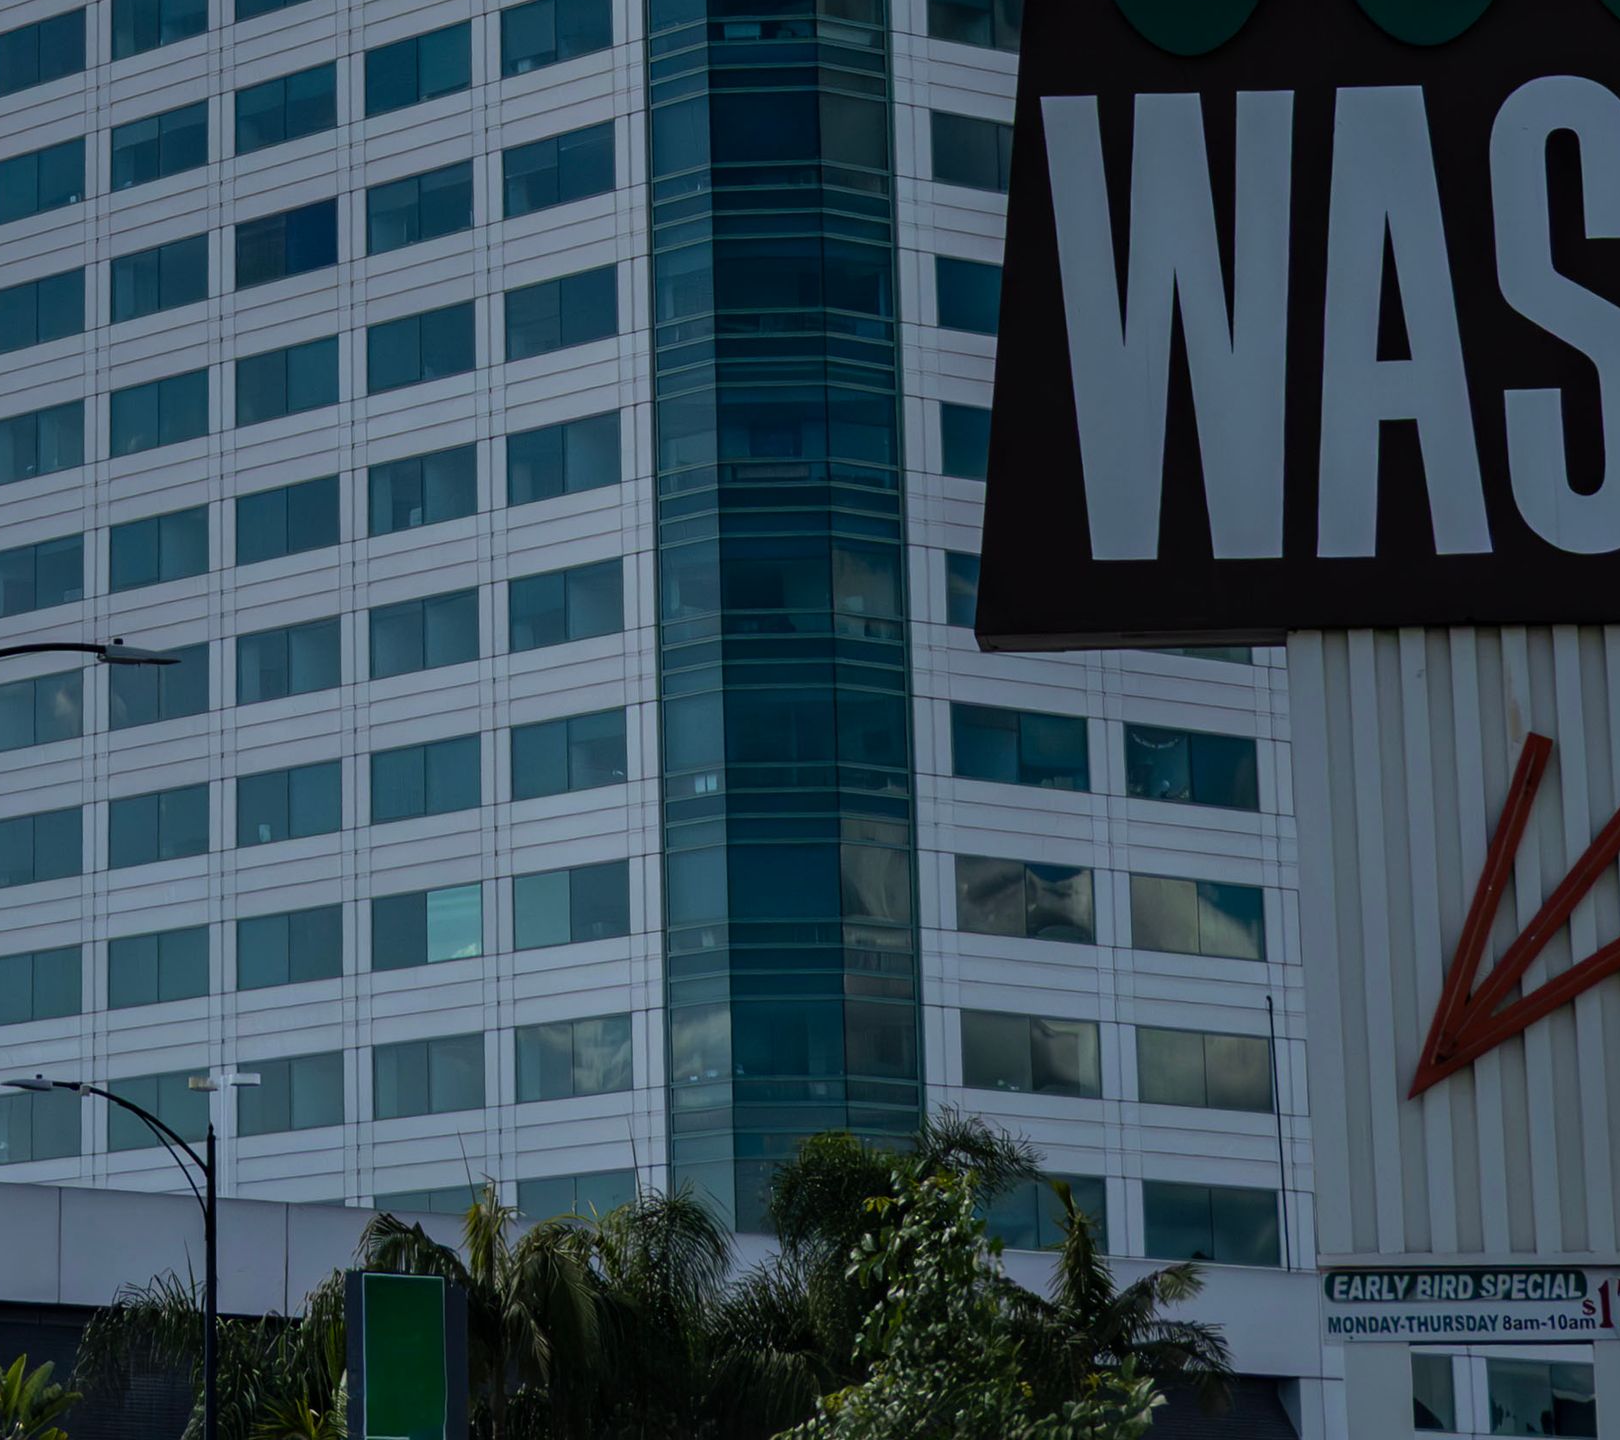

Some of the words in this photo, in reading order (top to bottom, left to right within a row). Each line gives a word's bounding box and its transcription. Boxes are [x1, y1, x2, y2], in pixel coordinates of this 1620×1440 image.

[1333, 1275, 1410, 1301] EARLY
[1416, 1274, 1474, 1300] BIRD
[1479, 1273, 1582, 1300] SPECIAL
[1328, 1315, 1499, 1334] MONDAY-THURSDAY
[1502, 1314, 1597, 1331] 8am-10am
